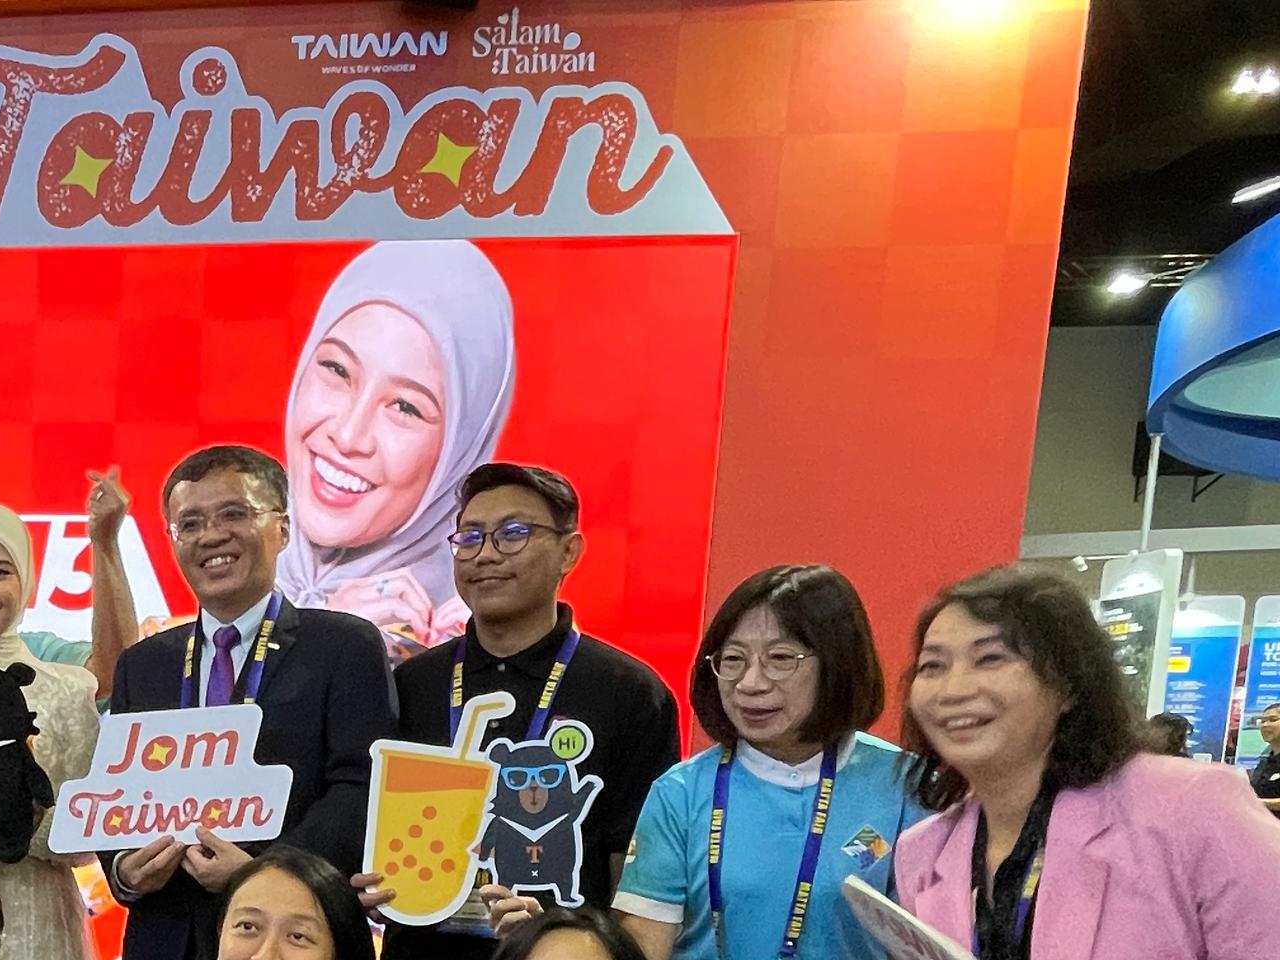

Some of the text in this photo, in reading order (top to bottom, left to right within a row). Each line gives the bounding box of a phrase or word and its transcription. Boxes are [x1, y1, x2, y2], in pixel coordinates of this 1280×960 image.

[291, 31, 448, 60] TAIWAN
[472, 6, 561, 58] Salam
[372, 63, 416, 73] WONDER
[496, 46, 595, 74] Taiwan
[106, 722, 240, 774] Jom
[559, 737, 576, 750] Hi
[69, 788, 274, 838] Taiwan
